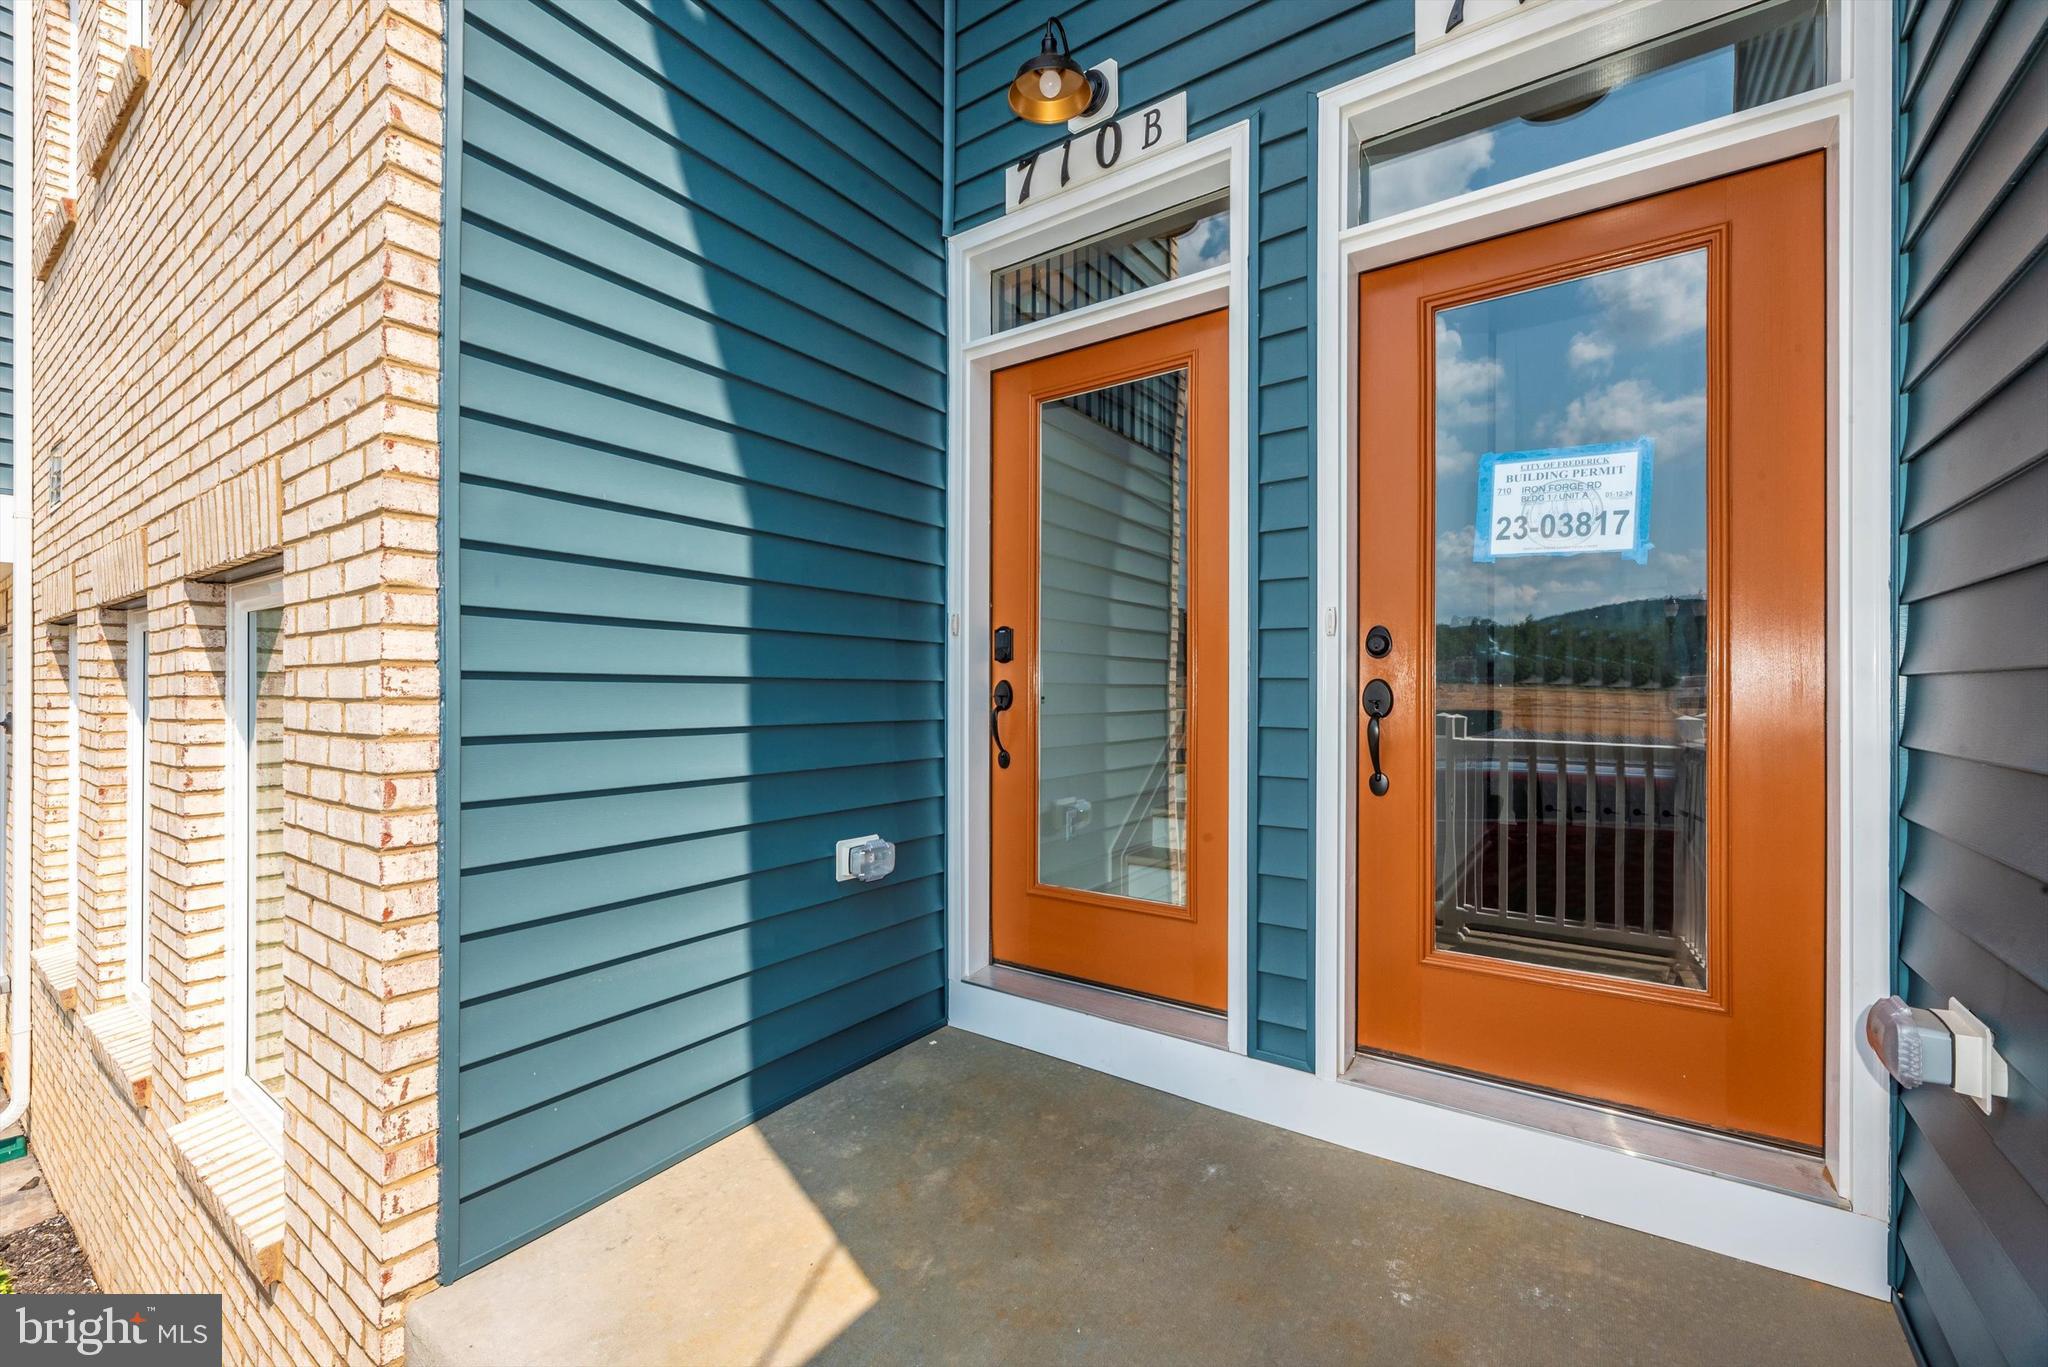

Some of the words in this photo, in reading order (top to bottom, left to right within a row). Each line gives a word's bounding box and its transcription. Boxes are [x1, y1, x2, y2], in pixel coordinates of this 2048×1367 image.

[1017, 121, 1122, 204] 710
[1142, 108, 1162, 150] B
[1543, 461, 1556, 469] OF
[1557, 457, 1609, 468] FREDERICK
[1506, 470, 1569, 483] BUILDING
[1572, 465, 1626, 478] PERMIT
[1497, 487, 1512, 496] 710
[1522, 485, 1546, 494] IRON
[1549, 482, 1584, 492] FORGE
[1587, 481, 1602, 489] RD
[1521, 494, 1545, 503] BLDG
[1559, 491, 1579, 500] UNIT
[1496, 509, 1630, 541] 23-03817
